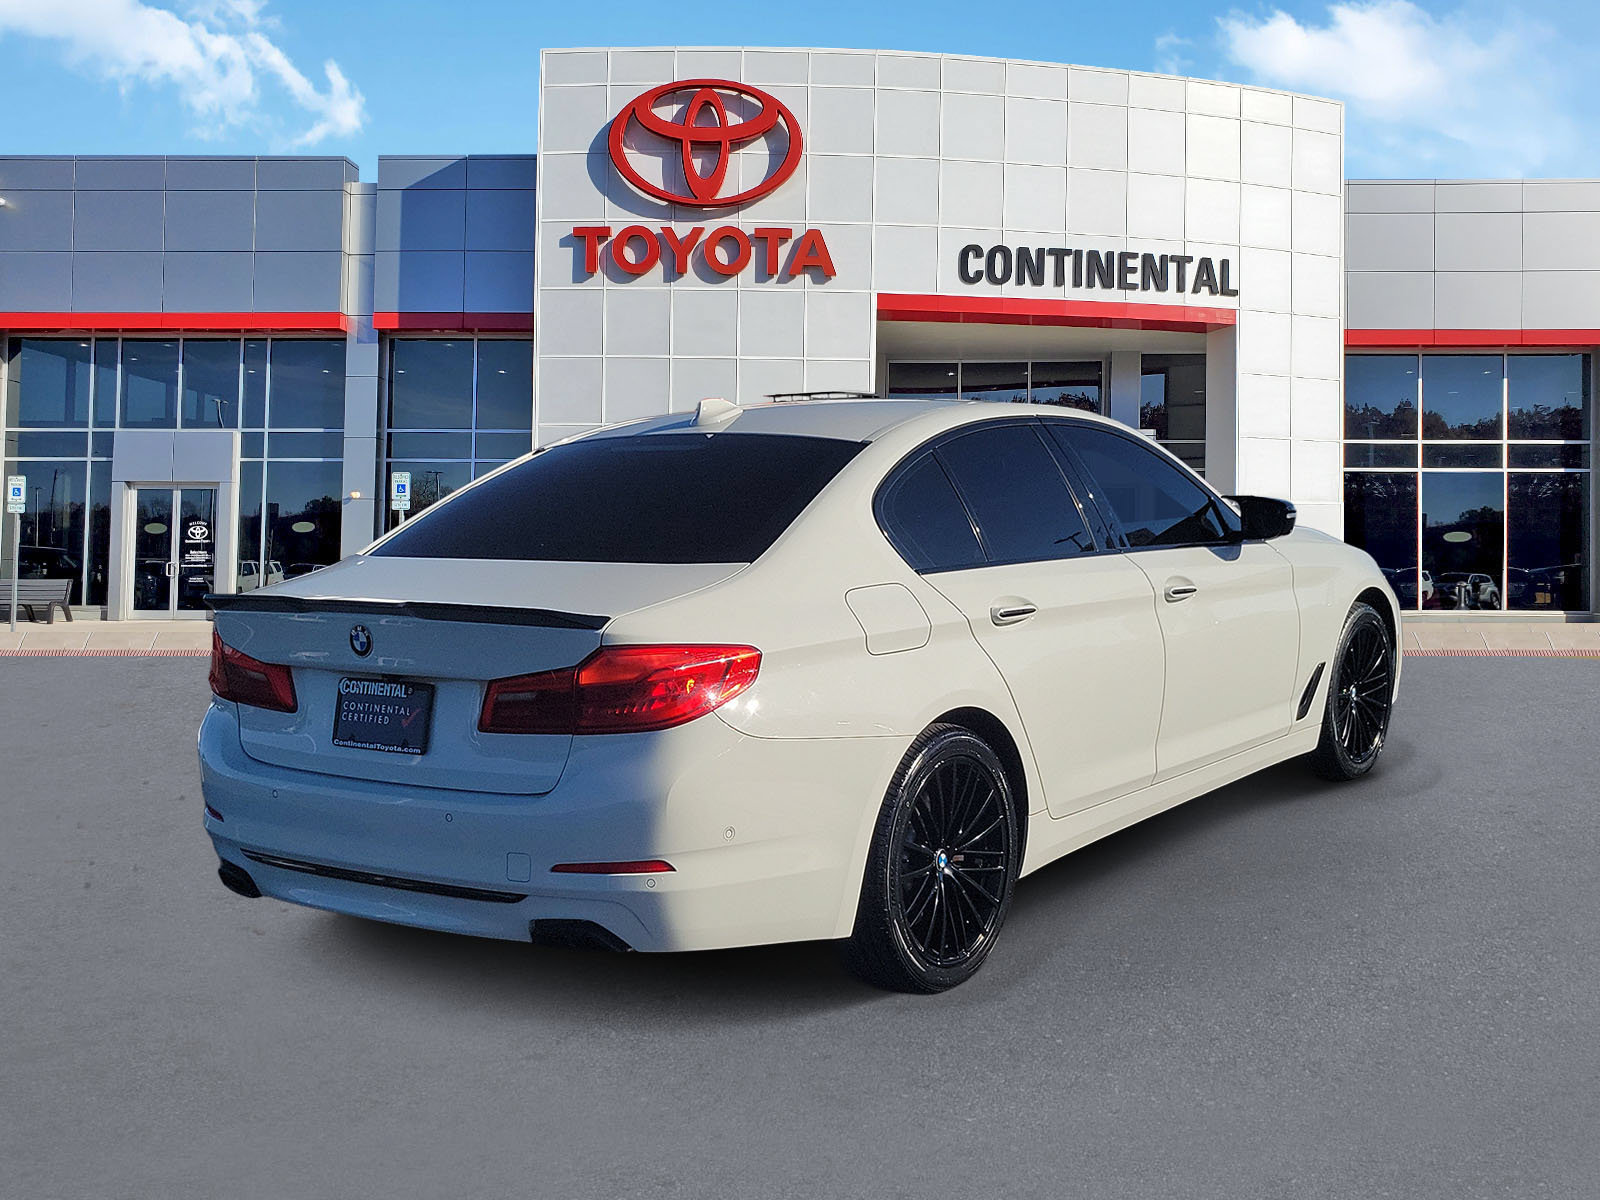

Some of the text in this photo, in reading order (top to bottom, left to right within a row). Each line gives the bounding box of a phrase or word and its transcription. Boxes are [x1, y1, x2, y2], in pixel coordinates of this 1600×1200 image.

[572, 225, 837, 277] TOYOTA
[958, 244, 1239, 297] CONTINENTAL
[339, 677, 408, 698] CONTINENTAL
[343, 701, 410, 716] CONTINENTAL
[341, 712, 390, 725] CERTIFIED
[333, 739, 421, 754] ContinentalToyota.com
